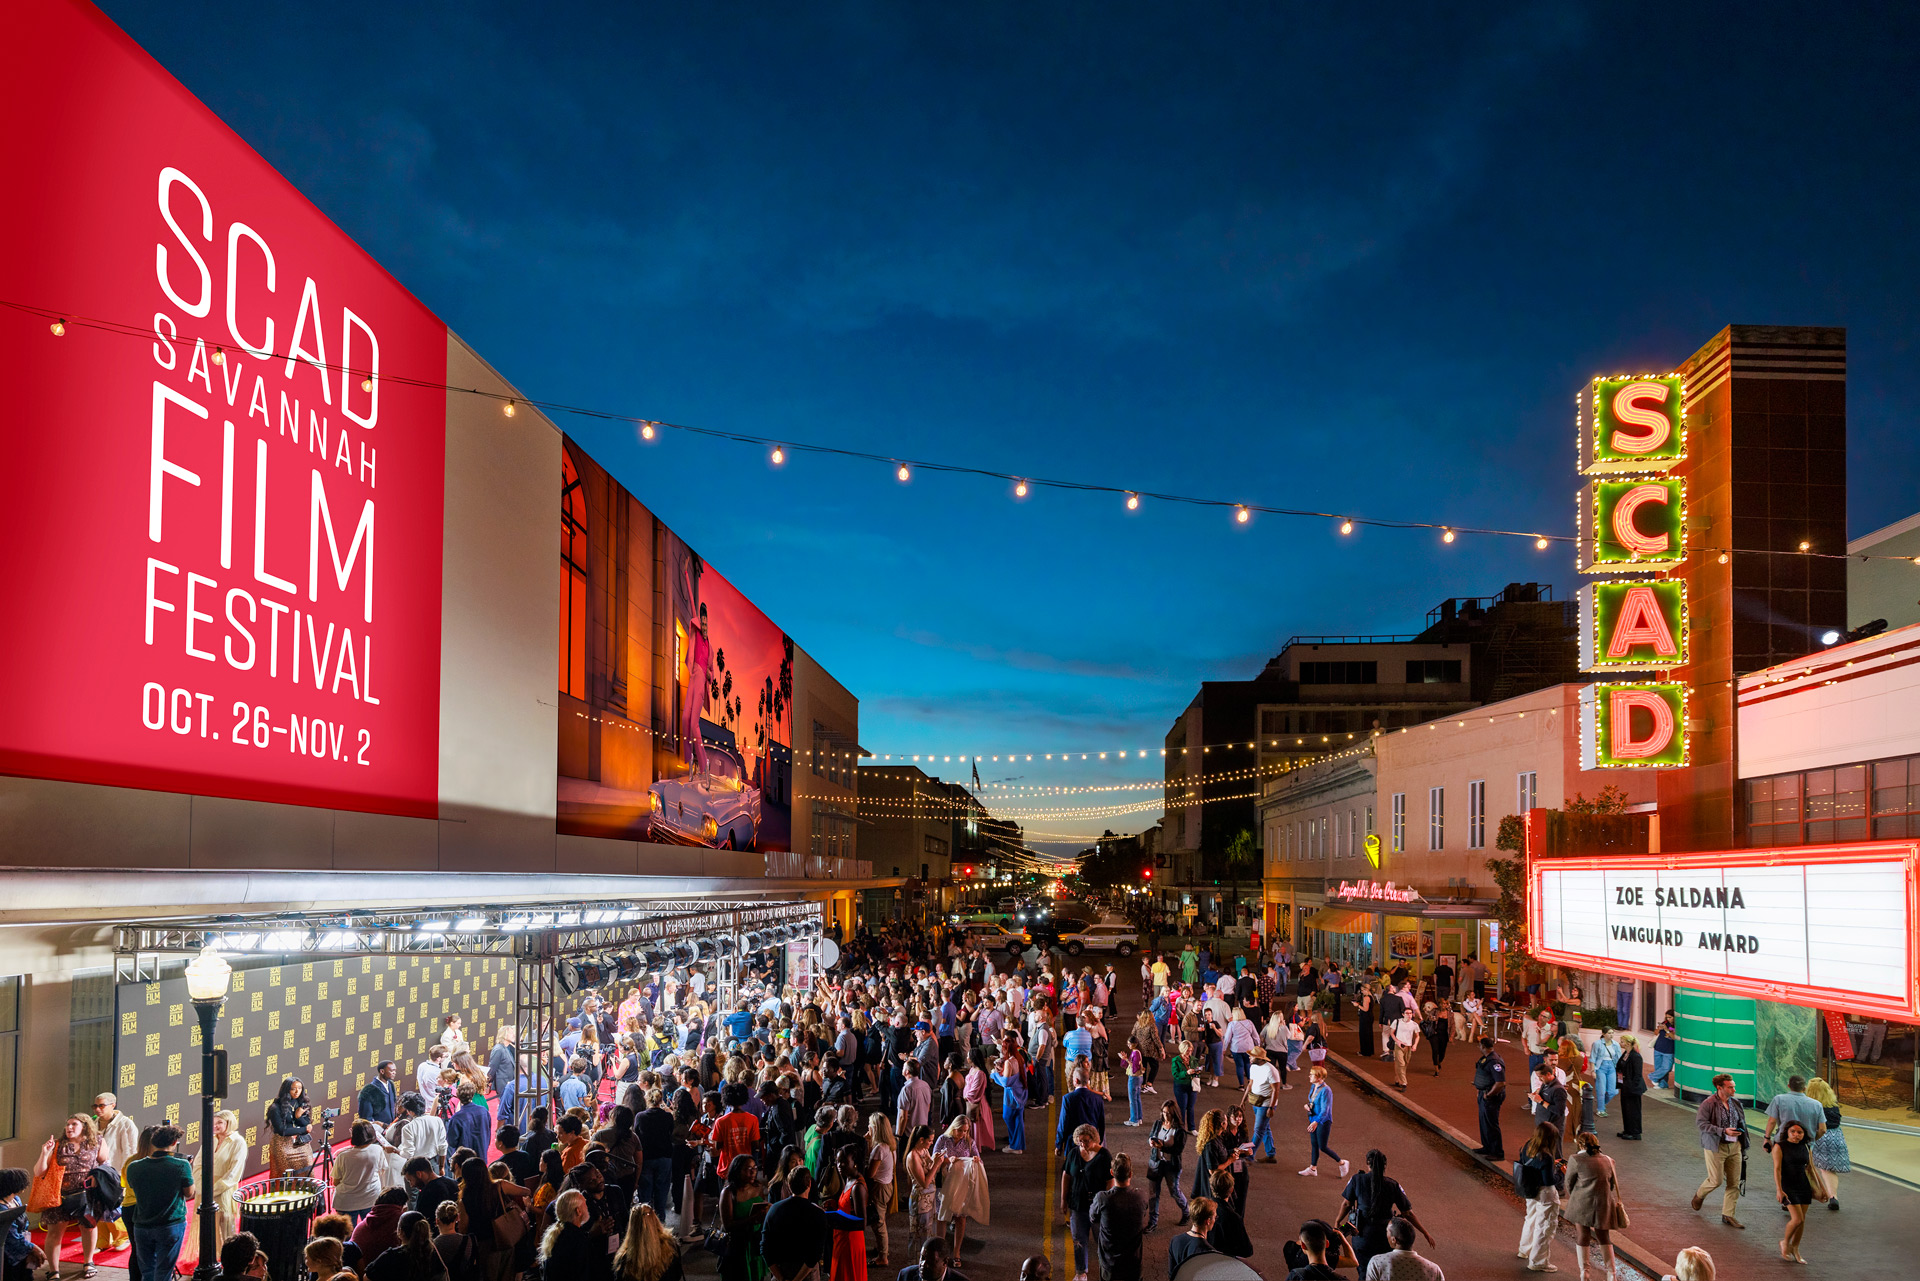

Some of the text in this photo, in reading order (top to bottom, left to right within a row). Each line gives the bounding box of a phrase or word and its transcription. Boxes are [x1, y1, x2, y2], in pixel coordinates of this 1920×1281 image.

[156, 166, 379, 429] SCAD
[152, 312, 377, 489] SAVANNAH
[149, 380, 375, 623] FILM
[1608, 381, 1678, 759] SCAD
[145, 557, 380, 705] FESTIVAL
[142, 681, 219, 740] OCT.
[357, 728, 371, 766] 2
[1370, 881, 1383, 899] Ice
[1384, 881, 1409, 903] Cream
[1616, 886, 1746, 909] ZOE SALDANA
[1611, 925, 1760, 954] VANGUARD AWARD
[146, 983, 160, 991] SCAD
[146, 992, 160, 1001] FILM
[169, 1004, 183, 1012] SCAD
[122, 1012, 137, 1020] SCAD
[169, 1013, 183, 1022] FILM
[122, 1021, 137, 1031] FILM
[146, 1033, 160, 1041] SCAD
[146, 1042, 160, 1052] FILM
[168, 1053, 182, 1061] SCAD
[120, 1064, 136, 1073] SCAD
[168, 1062, 182, 1072] FILM
[120, 1074, 136, 1084] FILM
[189, 1072, 202, 1080] SCAD
[143, 1083, 158, 1092] SCAD
[189, 1081, 202, 1091] FILM
[143, 1093, 158, 1103] FILM
[166, 1103, 179, 1111] SCAD
[186, 1121, 200, 1129] SCAD
[186, 1130, 200, 1140] FILM
